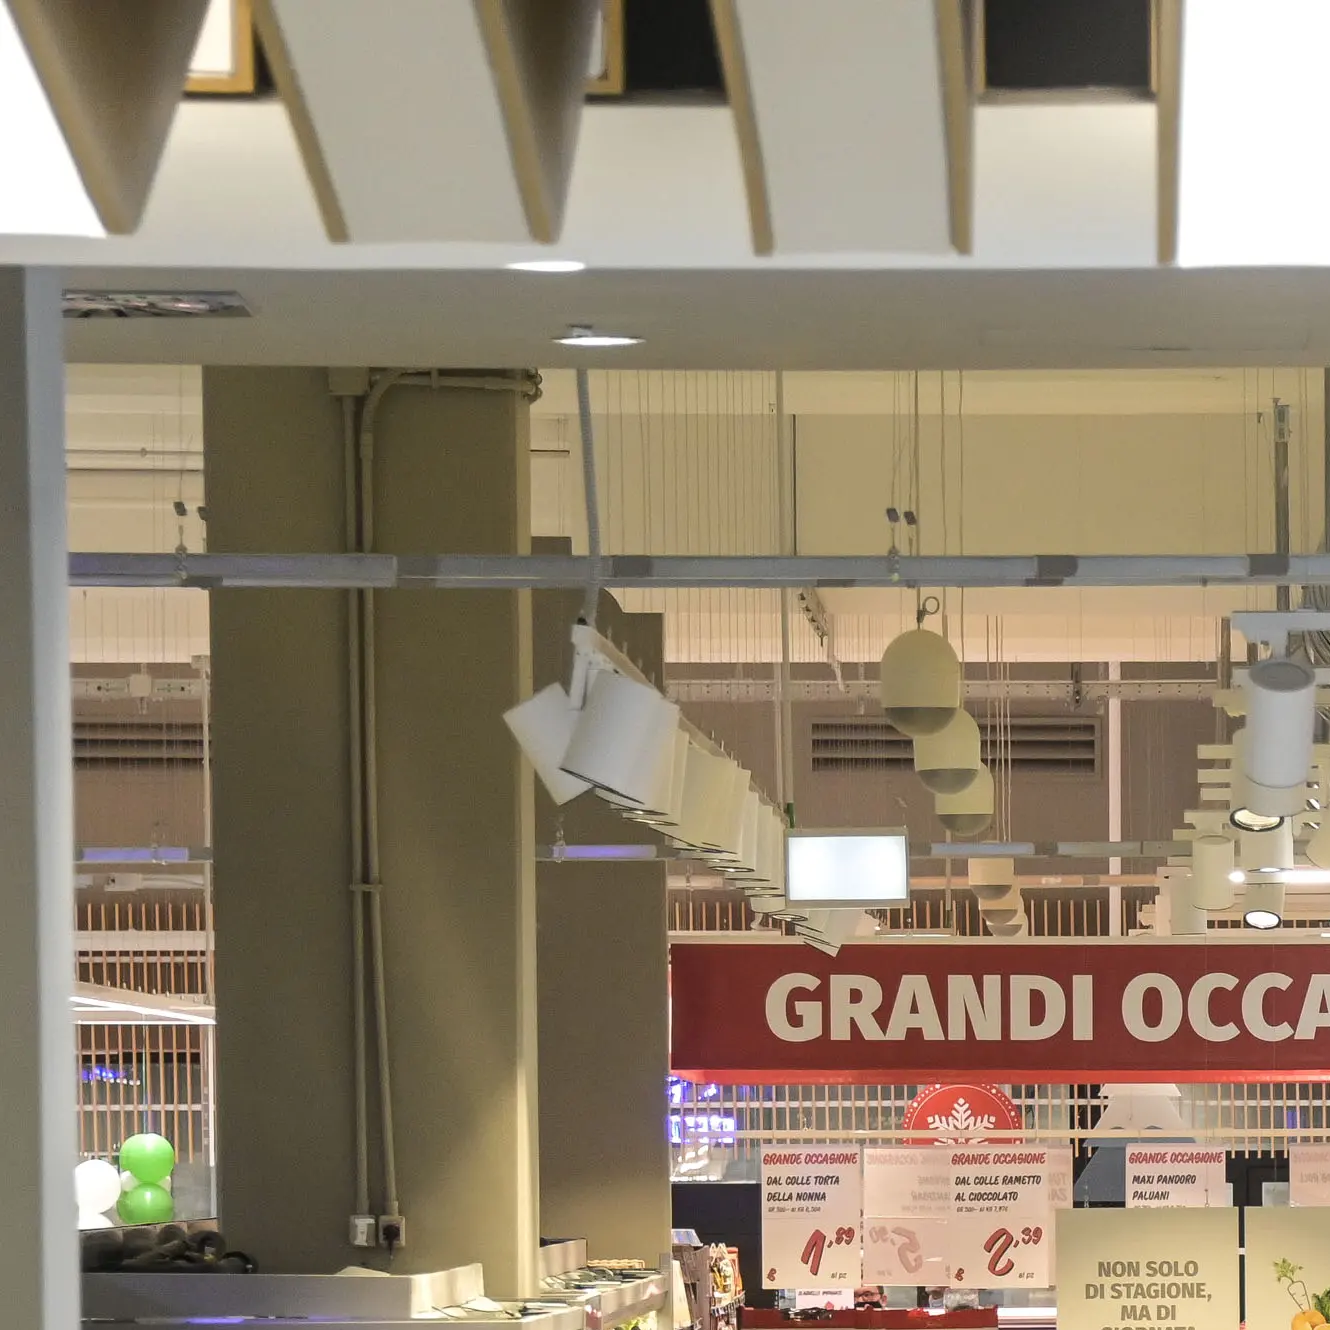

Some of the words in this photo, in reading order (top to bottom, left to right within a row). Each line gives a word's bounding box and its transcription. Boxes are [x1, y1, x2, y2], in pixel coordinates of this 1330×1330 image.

[765, 971, 1093, 1042] GRANDI
[763, 1152, 804, 1165] GRANDE
[805, 1152, 858, 1164] OCCASIONE
[951, 1153, 990, 1165] GRANDE
[992, 1152, 1046, 1165] OCCASIONE
[1129, 1152, 1168, 1164] GRANDE
[1170, 1152, 1223, 1164] OCCASIONE
[767, 1176, 783, 1186] DAL
[785, 1176, 812, 1186] COLLE
[813, 1175, 840, 1186] TORTA
[955, 1176, 971, 1186] DAL
[973, 1176, 1000, 1186] COLLE
[1002, 1175, 1042, 1186] RAMETTO
[1132, 1174, 1154, 1185] MAXI
[1156, 1174, 1197, 1185] PANDORO
[767, 1192, 793, 1202] DELLA
[795, 1192, 826, 1202] NONNA
[954, 1191, 966, 1202] AL
[968, 1191, 1019, 1202] CIOCCOLATO
[1132, 1190, 1169, 1201] PALUANI
[800, 1226, 856, 1276] 1,89
[984, 1226, 1043, 1276] 2,39
[1098, 1260, 1140, 1277] NON
[1145, 1260, 1199, 1277] SOLO
[1085, 1283, 1105, 1300] DI
[1110, 1283, 1212, 1302] STAGIONE,
[1121, 1305, 1152, 1321] MA
[1156, 1305, 1176, 1321] DI
